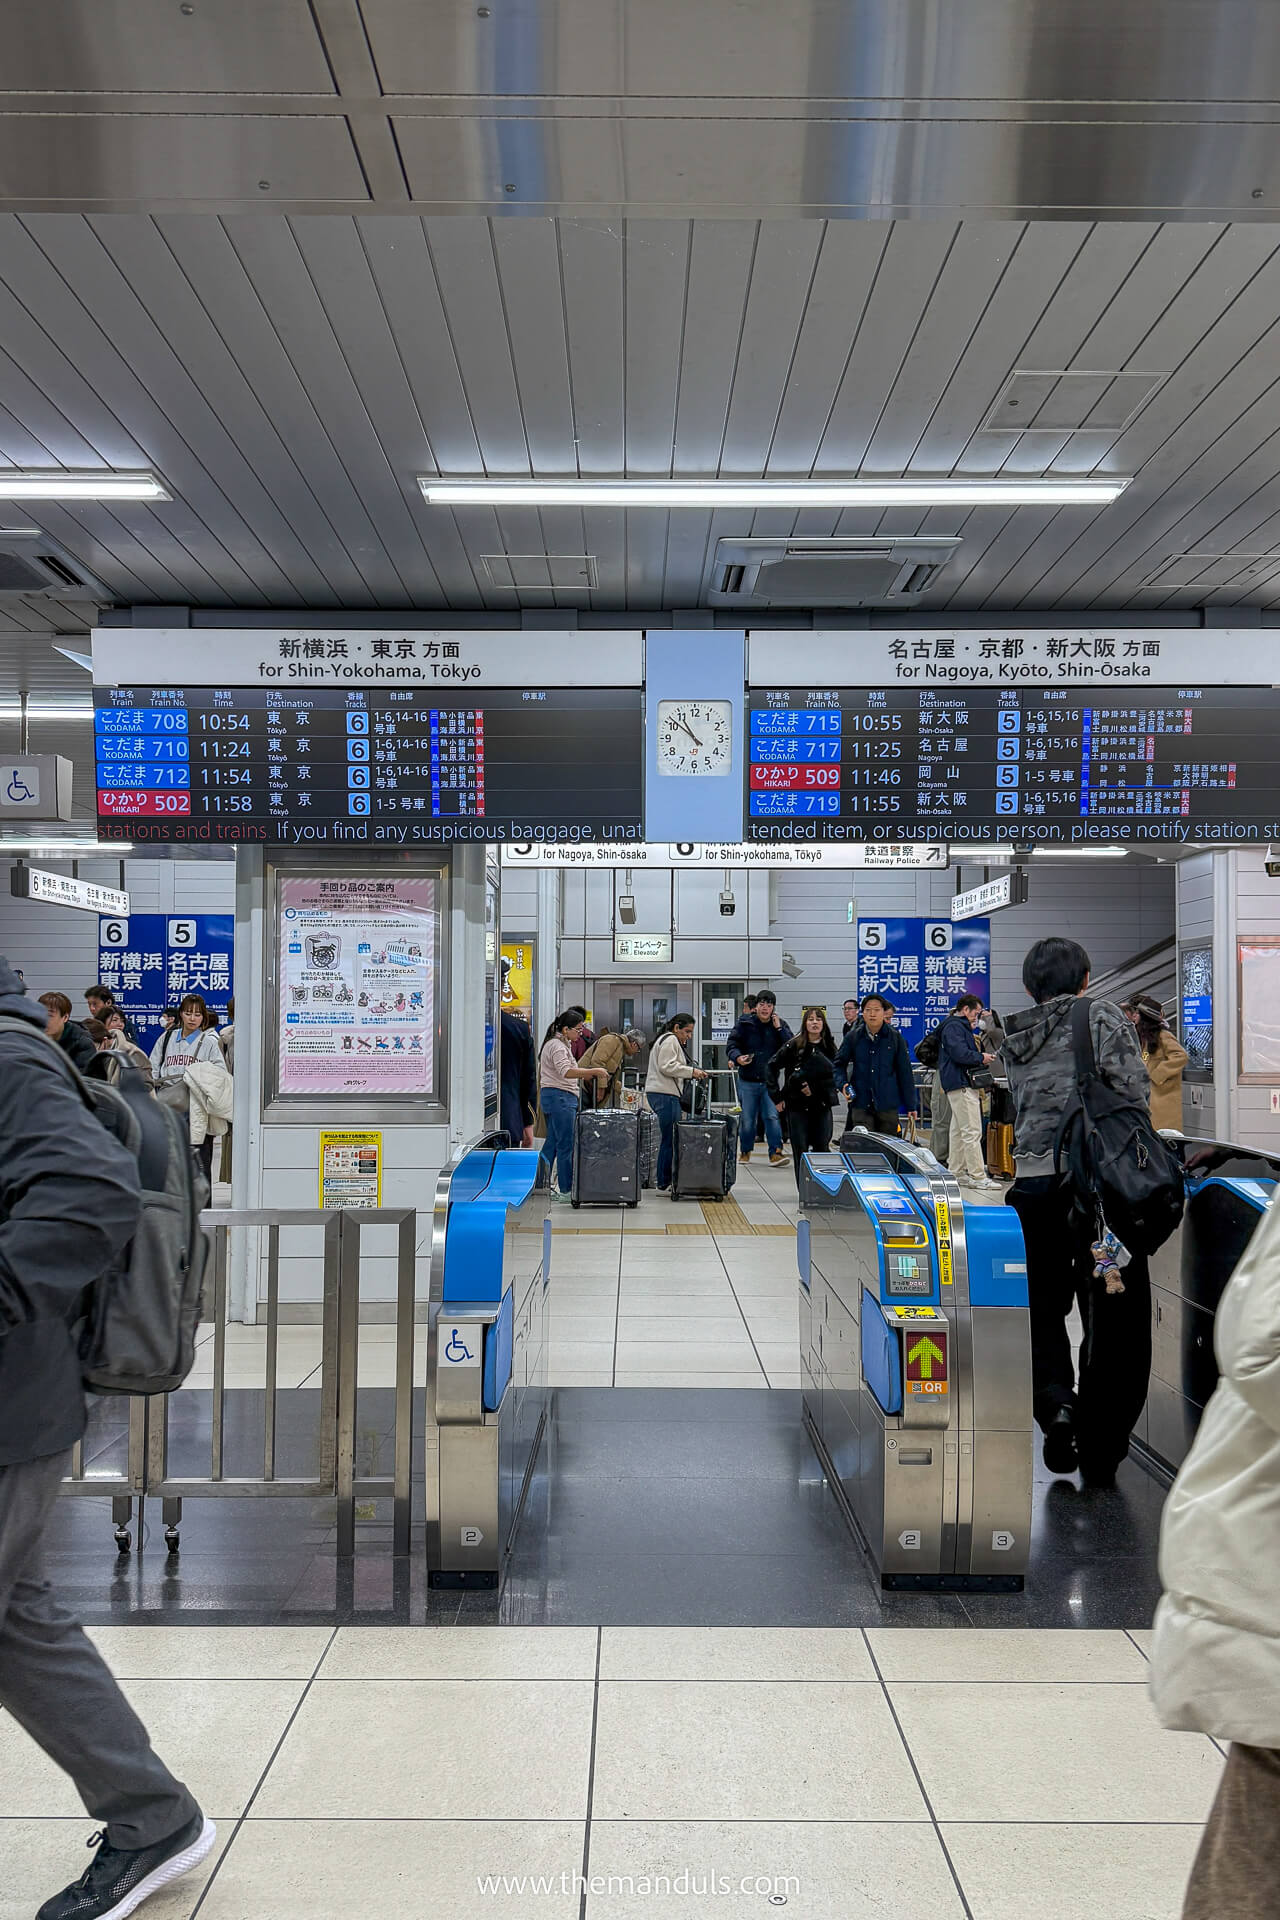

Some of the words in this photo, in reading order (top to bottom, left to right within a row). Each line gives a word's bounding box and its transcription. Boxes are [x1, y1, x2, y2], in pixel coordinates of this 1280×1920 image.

[258, 662, 283, 678] for
[289, 662, 426, 681] Shin-Yokohama,
[431, 663, 481, 682] Tōkyō
[896, 663, 921, 678] for
[926, 663, 992, 681] Nagoya,
[999, 662, 1052, 681] Kyōto,
[1057, 660, 1150, 678] Shin-Ōsaka
[111, 699, 133, 707] Train
[266, 700, 314, 708] Destination
[805, 700, 826, 708] Train
[867, 700, 887, 708] Time
[997, 699, 1019, 707] Tracks
[678, 713, 686, 721] 11
[690, 709, 700, 717] 12
[101, 710, 145, 724] こだま
[152, 714, 187, 730] 708
[199, 714, 250, 730] 10:54
[351, 715, 365, 731] 6
[374, 711, 427, 723] 1-6,14-16
[756, 713, 799, 726] こだま
[806, 715, 839, 731] 715
[852, 715, 902, 731] 10:55
[1002, 714, 1015, 730] 5
[1026, 711, 1079, 723] 1-6,15,16
[669, 722, 678, 730] 10
[714, 722, 720, 731] 2
[665, 734, 671, 742] 9
[718, 735, 724, 743] 3
[102, 738, 145, 751] こだま
[152, 741, 188, 757] 710
[200, 741, 251, 758] 11:24
[352, 742, 365, 759] 6
[375, 738, 428, 751] 1-6,14-16
[669, 747, 675, 755] 8
[713, 747, 719, 755] 4
[756, 740, 799, 753] こだま
[806, 742, 839, 758] 717
[852, 742, 901, 758] 11:25
[1002, 741, 1014, 757] 5
[1026, 738, 1078, 750] 1-6,15,16
[680, 757, 685, 765] 7
[705, 757, 711, 765] 5
[918, 754, 942, 762] Nagoya
[691, 760, 697, 769] 6
[103, 765, 146, 778] こだま
[153, 768, 188, 784] 712
[200, 768, 252, 785] 11:54
[352, 769, 366, 786] 6
[755, 767, 798, 779] ひかり
[805, 769, 839, 785] 509
[852, 769, 901, 785] 11:46
[1001, 768, 1014, 784] 5
[1025, 771, 1045, 782] 1-5
[1050, 770, 1074, 782] 号車
[763, 780, 791, 788] HIKARI
[103, 793, 148, 805] ひかり
[154, 796, 189, 812] 502
[202, 795, 253, 812] 11:58
[353, 796, 366, 813] 6
[376, 799, 397, 810] 1-5
[400, 798, 426, 810] 号車
[756, 793, 798, 806] こだま
[805, 796, 839, 812] 719
[851, 796, 900, 812] 11:55
[1001, 795, 1013, 811] 5
[1024, 792, 1076, 804] 1-6,15,16
[112, 806, 140, 814] HIKARI
[98, 822, 171, 839] stations
[175, 821, 211, 839] and
[277, 821, 289, 839] If
[293, 826, 326, 847] you
[331, 821, 367, 839] find
[375, 824, 408, 843] any
[413, 821, 505, 843] suspicious
[511, 821, 596, 843] baggage,
[748, 820, 816, 839] tended
[823, 821, 866, 842] item,
[873, 825, 893, 839] or
[897, 821, 990, 843] suspicious
[996, 825, 1064, 844] person,
[1071, 820, 1132, 844] please
[1136, 820, 1190, 843] notify
[1194, 821, 1258, 838] station
[543, 849, 555, 859] for
[559, 849, 594, 862] Nagoya,
[705, 850, 718, 860] for
[720, 850, 792, 862] Shin-yokohama,
[795, 849, 822, 862] Tōkyō
[864, 857, 894, 865] Railway
[33, 875, 39, 891] 6
[320, 882, 395, 892] 手回り品のご案内
[106, 923, 122, 944] 6
[174, 923, 190, 944] 5
[865, 927, 880, 947] 5
[931, 927, 947, 947] 6
[634, 941, 668, 949] エレベーター
[99, 952, 163, 972] 新横浜
[168, 952, 229, 971] 名古屋
[859, 955, 919, 974] 名古屋
[924, 955, 987, 974] 新横浜
[100, 972, 143, 990] 東京
[168, 973, 229, 991] 新大阪
[859, 975, 920, 993] 新大阪
[925, 975, 967, 993] 東京
[925, 995, 949, 1006] 方面
[924, 1382, 943, 1392] QR
[466, 1532, 476, 1542] 2
[905, 1535, 916, 1545] 2
[997, 1536, 1008, 1545] 3
